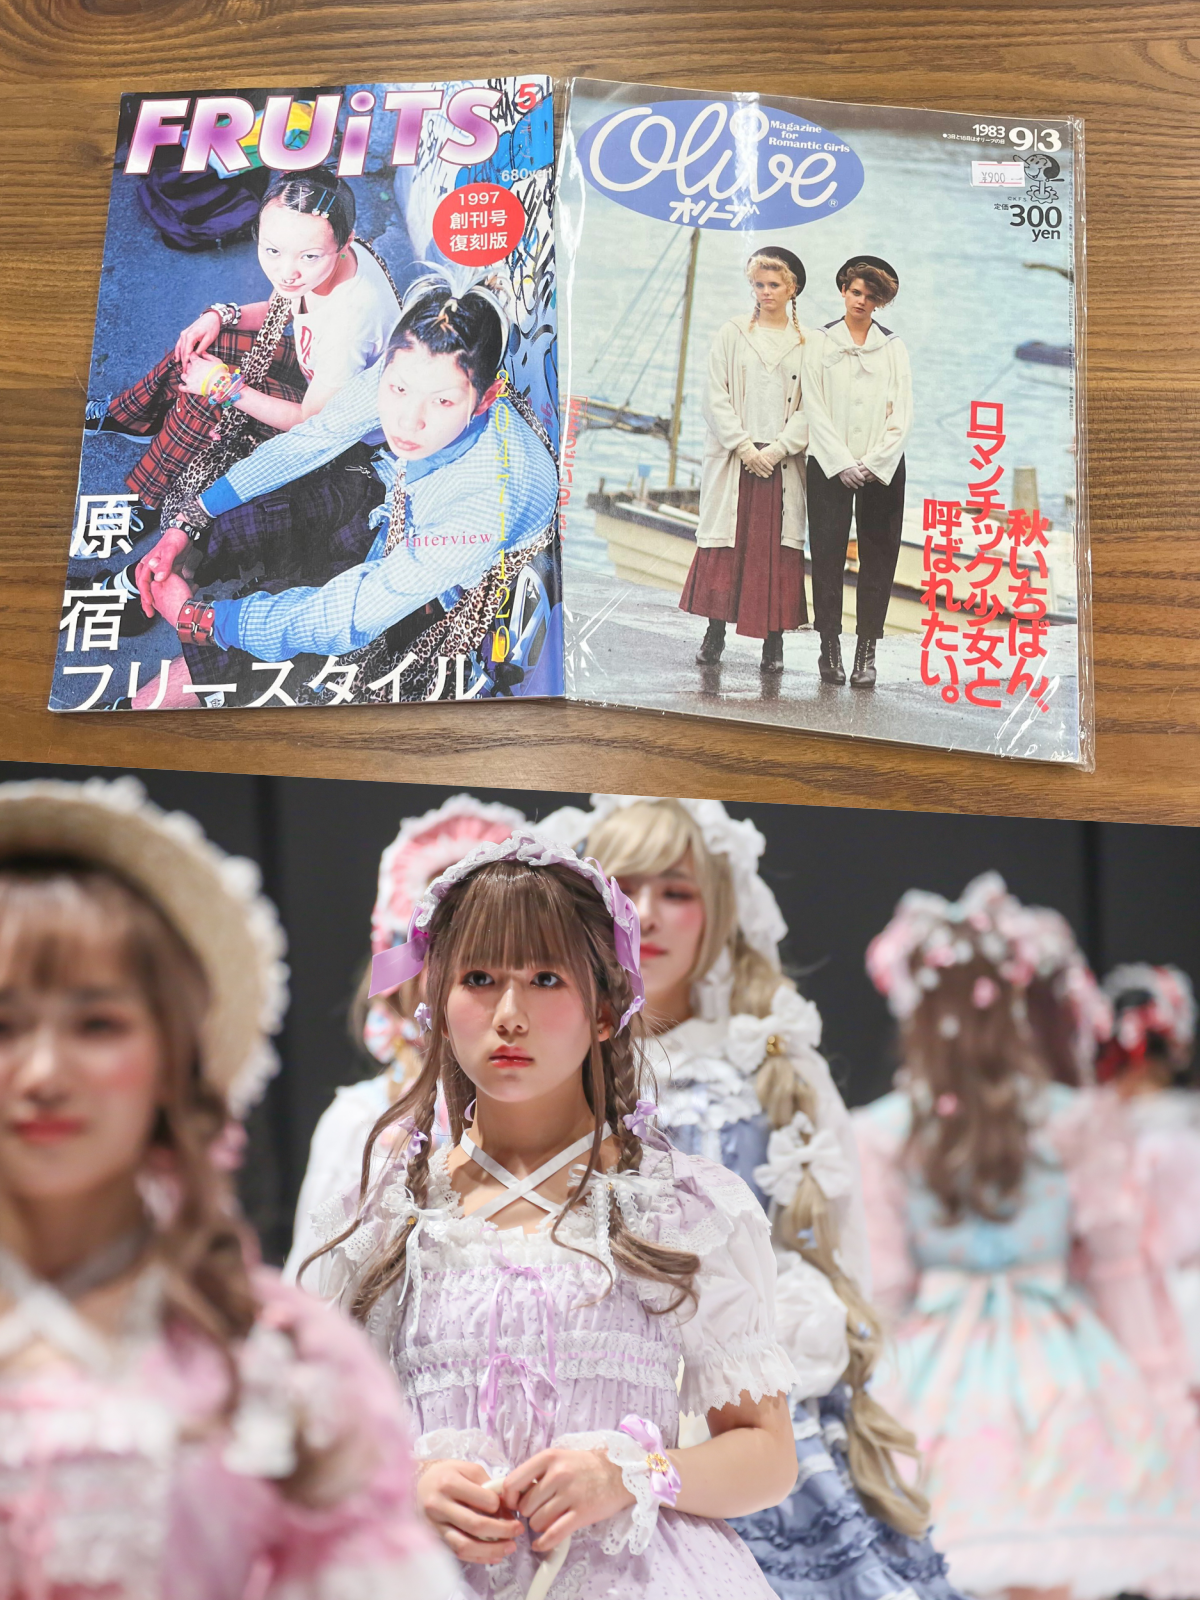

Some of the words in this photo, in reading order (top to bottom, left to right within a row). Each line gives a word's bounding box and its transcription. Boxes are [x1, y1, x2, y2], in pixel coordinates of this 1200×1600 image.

[517, 83, 537, 110] 5
[123, 87, 503, 178] FRUiTS
[770, 120, 822, 133] Magazine
[781, 131, 799, 140] for
[972, 124, 1006, 138] 1983
[590, 102, 838, 208] Olive
[768, 136, 822, 150] Romantic
[823, 142, 851, 153] Girls
[458, 191, 500, 206] 1997
[993, 203, 1009, 211] 定価
[449, 209, 508, 230] 創刊号
[1009, 204, 1063, 229] 300
[449, 231, 508, 252] 復刻版
[1031, 228, 1061, 242] yen
[405, 532, 493, 548] interview
[962, 400, 1006, 708] ロマンチック少女と
[919, 498, 963, 704] 呼ばれたい。
[62, 653, 488, 711] フリースタイル
